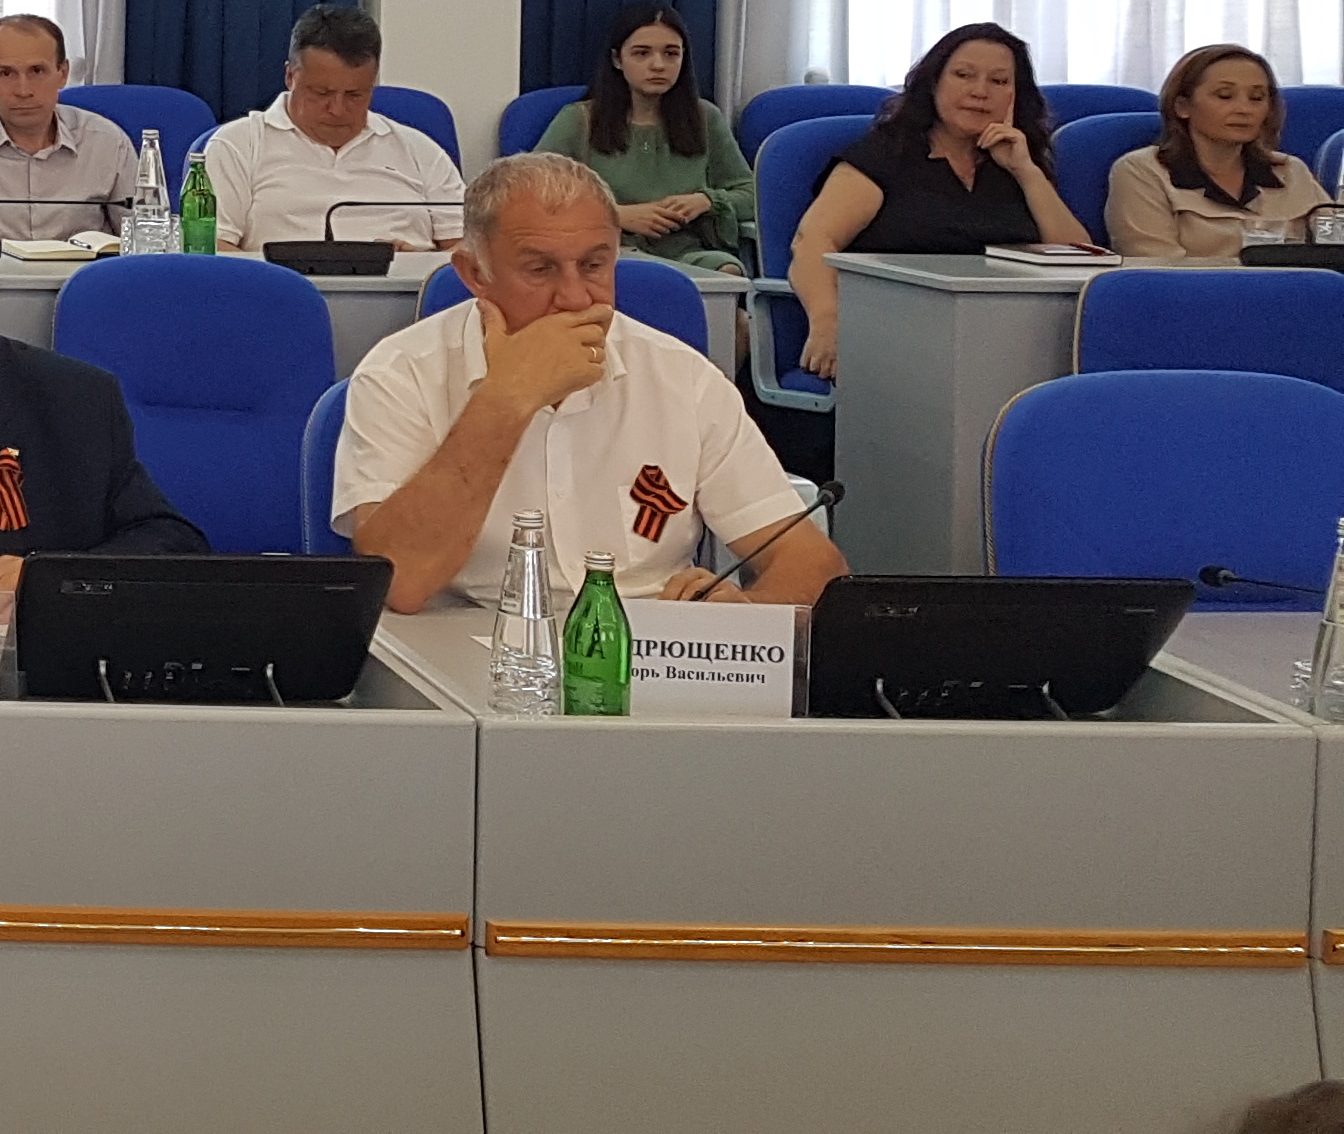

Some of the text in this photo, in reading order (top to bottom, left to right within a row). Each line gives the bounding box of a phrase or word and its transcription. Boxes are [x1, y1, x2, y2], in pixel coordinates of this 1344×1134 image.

[631, 638, 786, 664] ДРЮЩЕНКО
[630, 665, 766, 684] орь Васильевич
